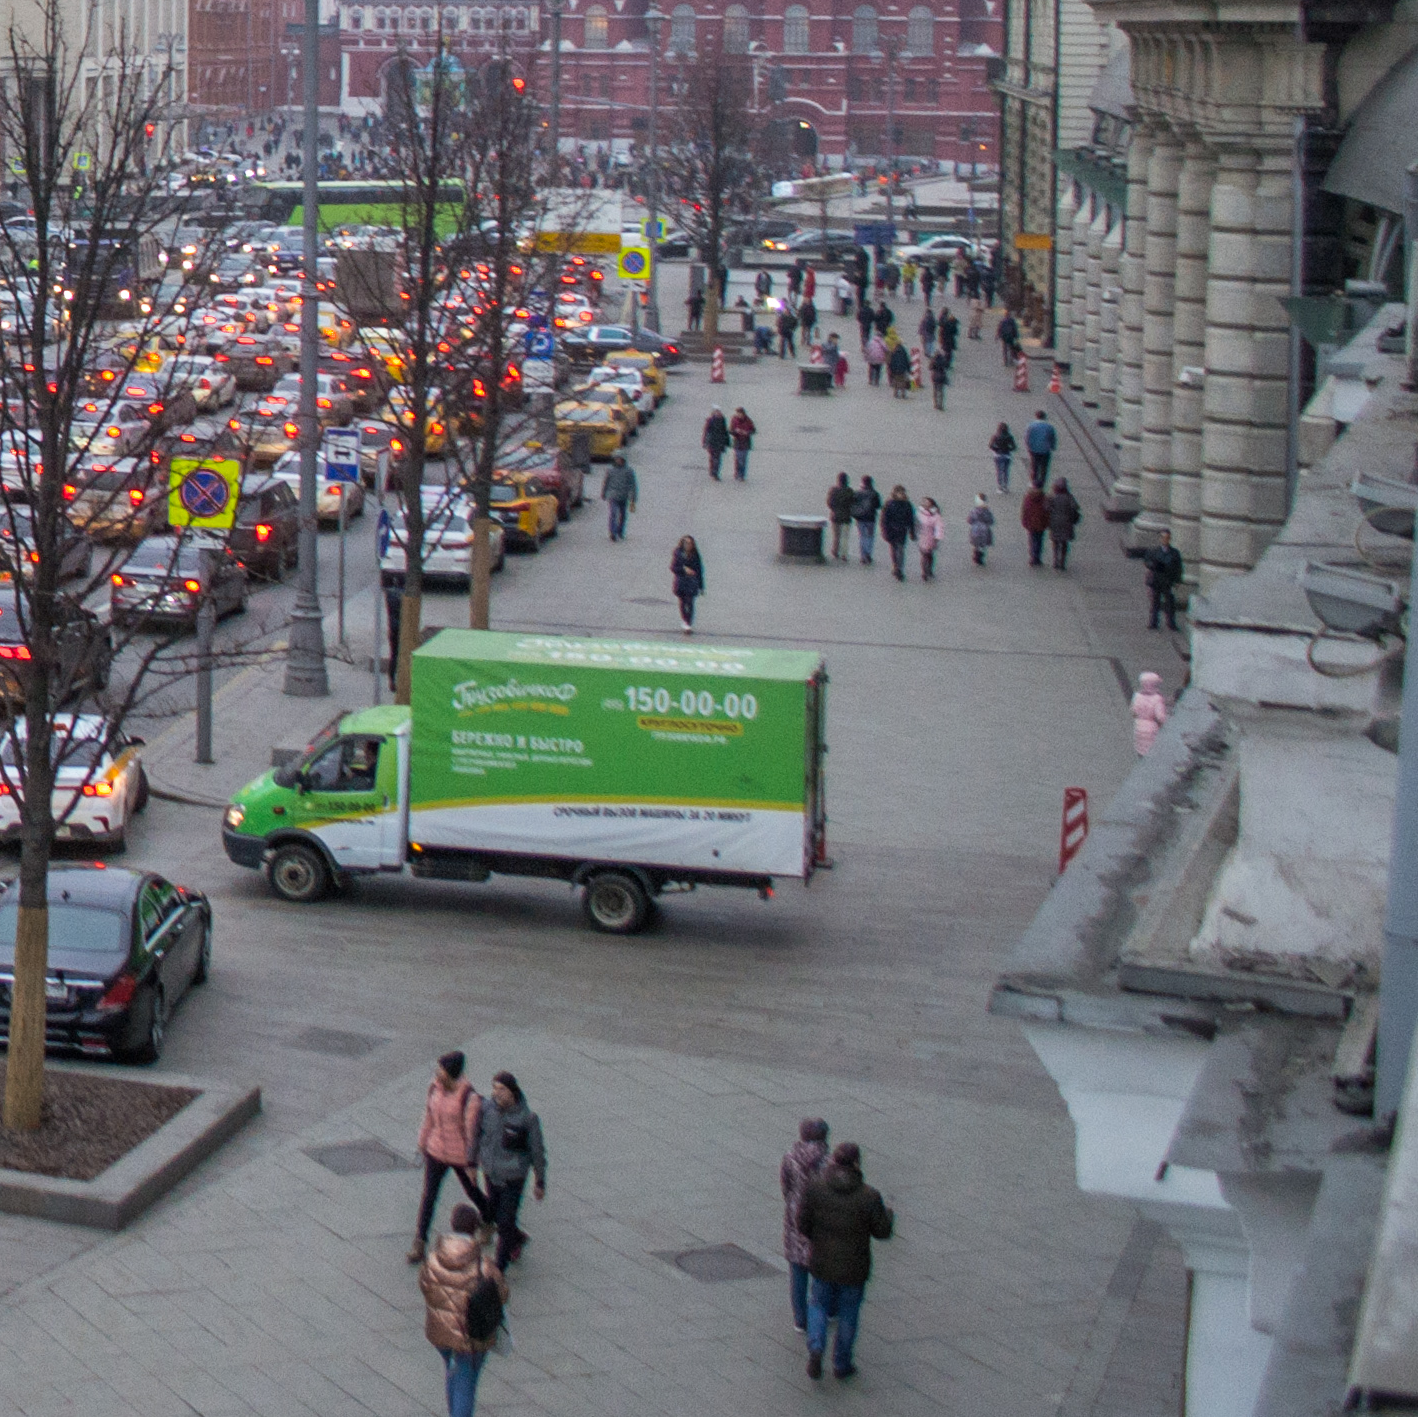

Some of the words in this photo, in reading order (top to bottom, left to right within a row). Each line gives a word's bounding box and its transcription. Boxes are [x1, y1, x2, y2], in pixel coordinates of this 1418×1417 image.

[624, 685, 759, 720] 150-00-00
[451, 730, 513, 748] БЕРЕЖНО
[529, 736, 585, 754] БЫСТРО
